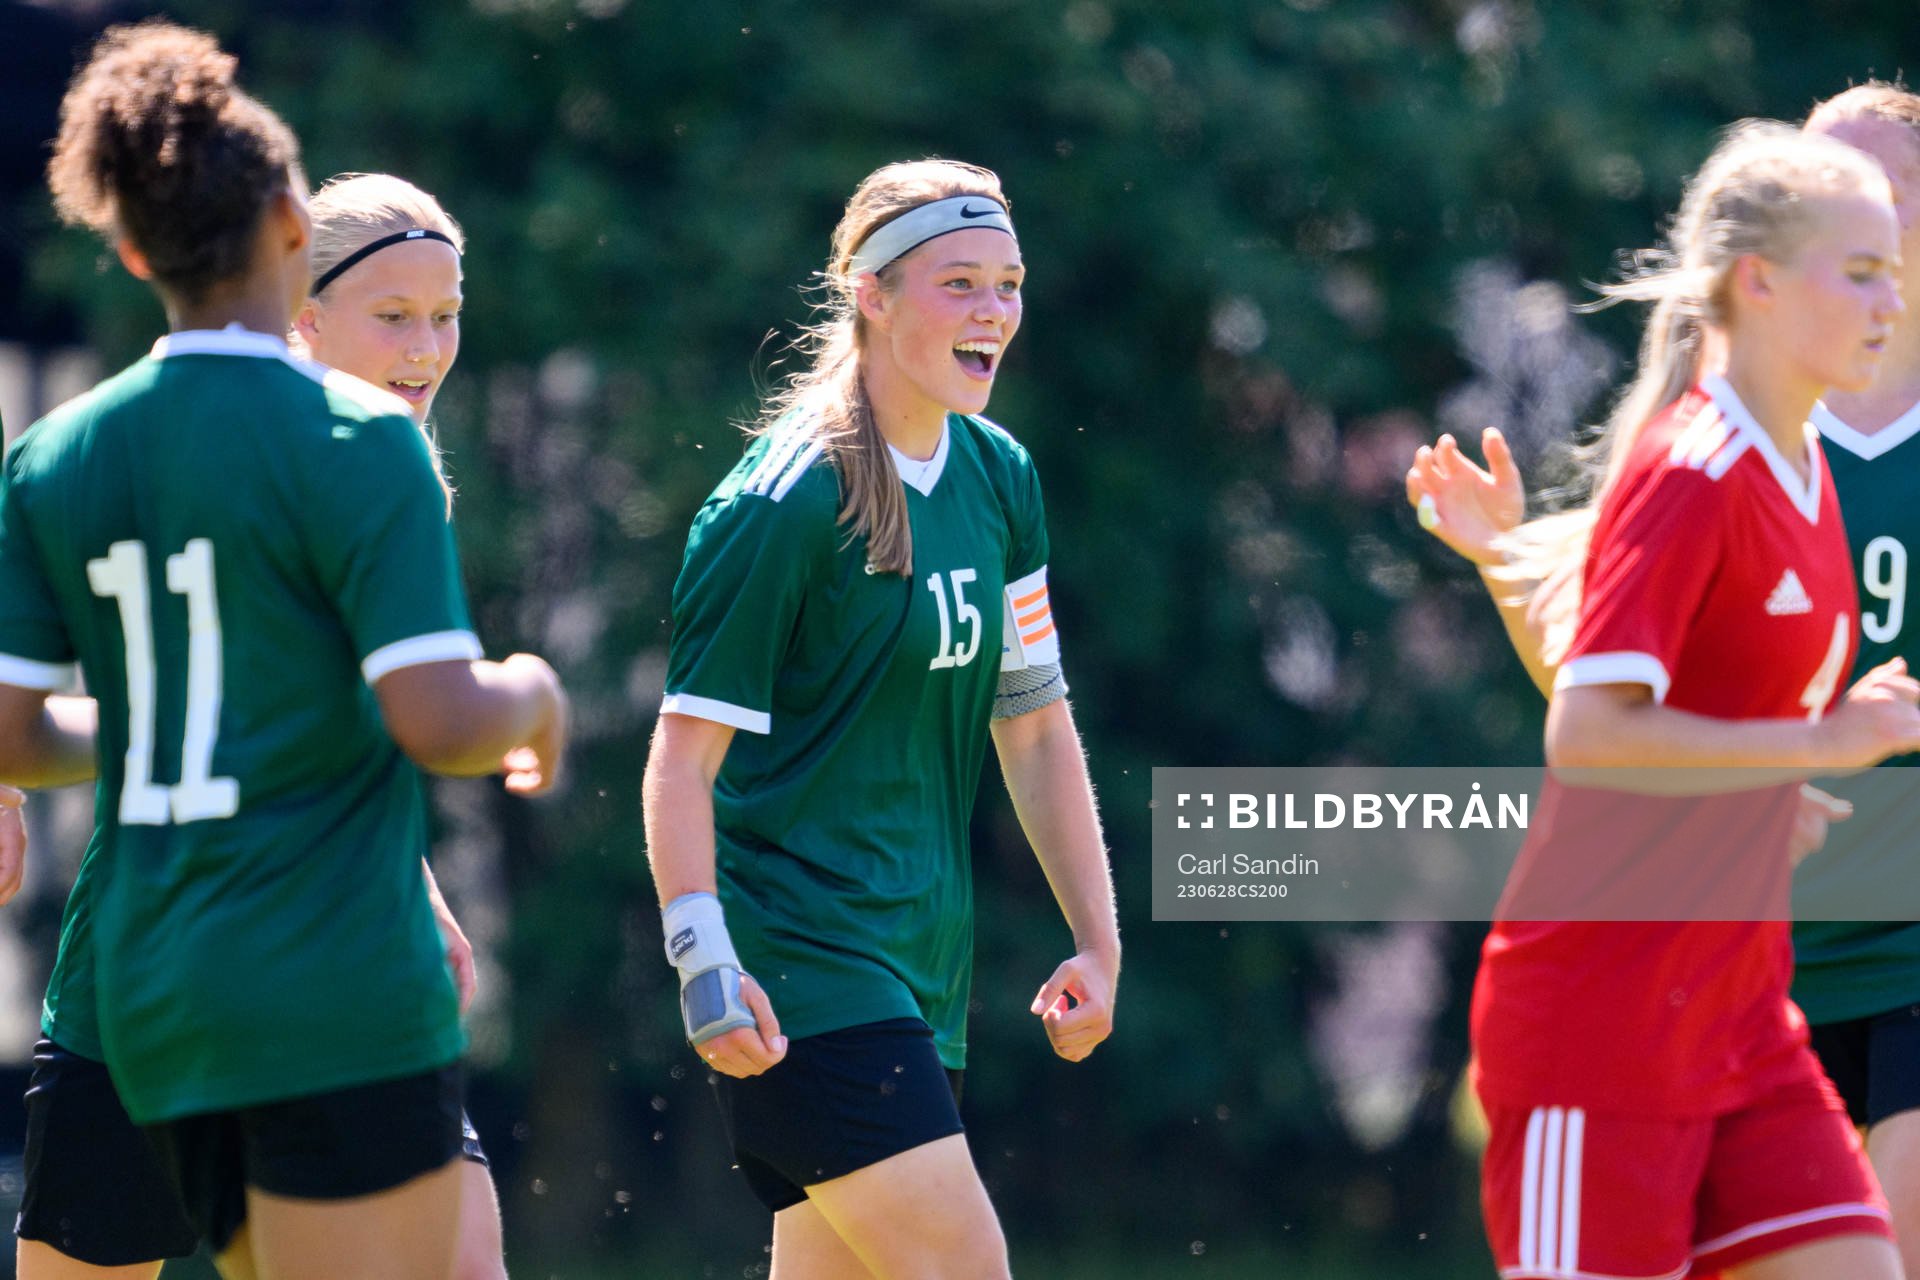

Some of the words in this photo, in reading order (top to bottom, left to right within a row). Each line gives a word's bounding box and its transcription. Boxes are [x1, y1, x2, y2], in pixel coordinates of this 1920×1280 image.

[927, 567, 982, 671] 15
[1861, 535, 1908, 644] 9
[86, 537, 240, 826] 11
[1798, 611, 1850, 726] 4
